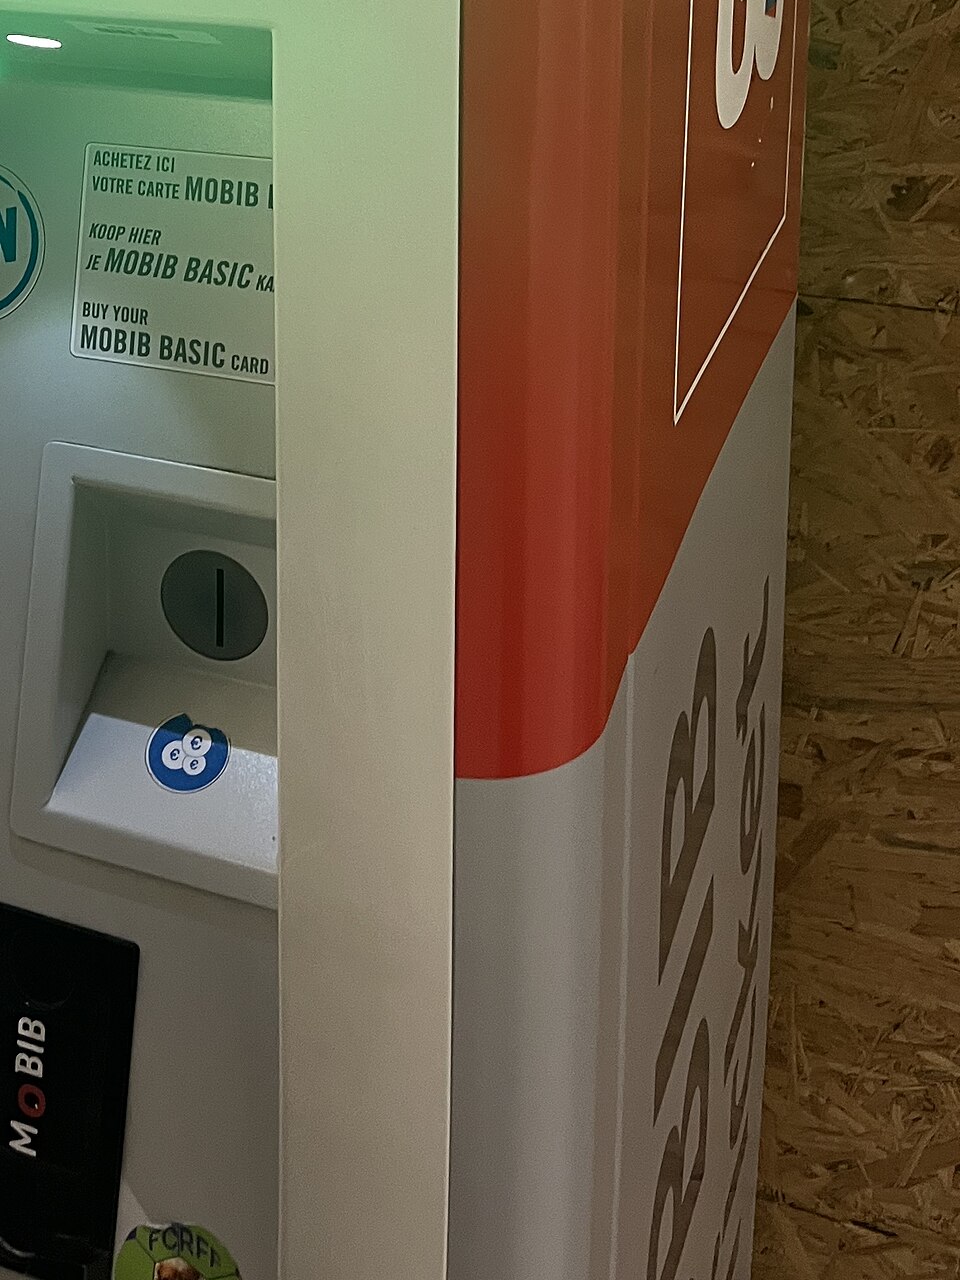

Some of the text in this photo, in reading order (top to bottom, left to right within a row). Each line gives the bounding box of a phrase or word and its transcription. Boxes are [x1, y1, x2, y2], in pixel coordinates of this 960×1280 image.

[93, 150, 175, 173] ACHETEZ ICI
[92, 175, 133, 195] VOTRE
[137, 180, 180, 199] CARTE
[185, 176, 259, 208] MOBIB
[89, 222, 162, 245] KOOP HIER
[85, 248, 275, 293] JE MOBIB BASIC KA
[82, 301, 148, 325] BUY YOUR
[80, 324, 269, 375] MOBIB BASIC CARD
[8, 1016, 46, 1158] MOBIB
